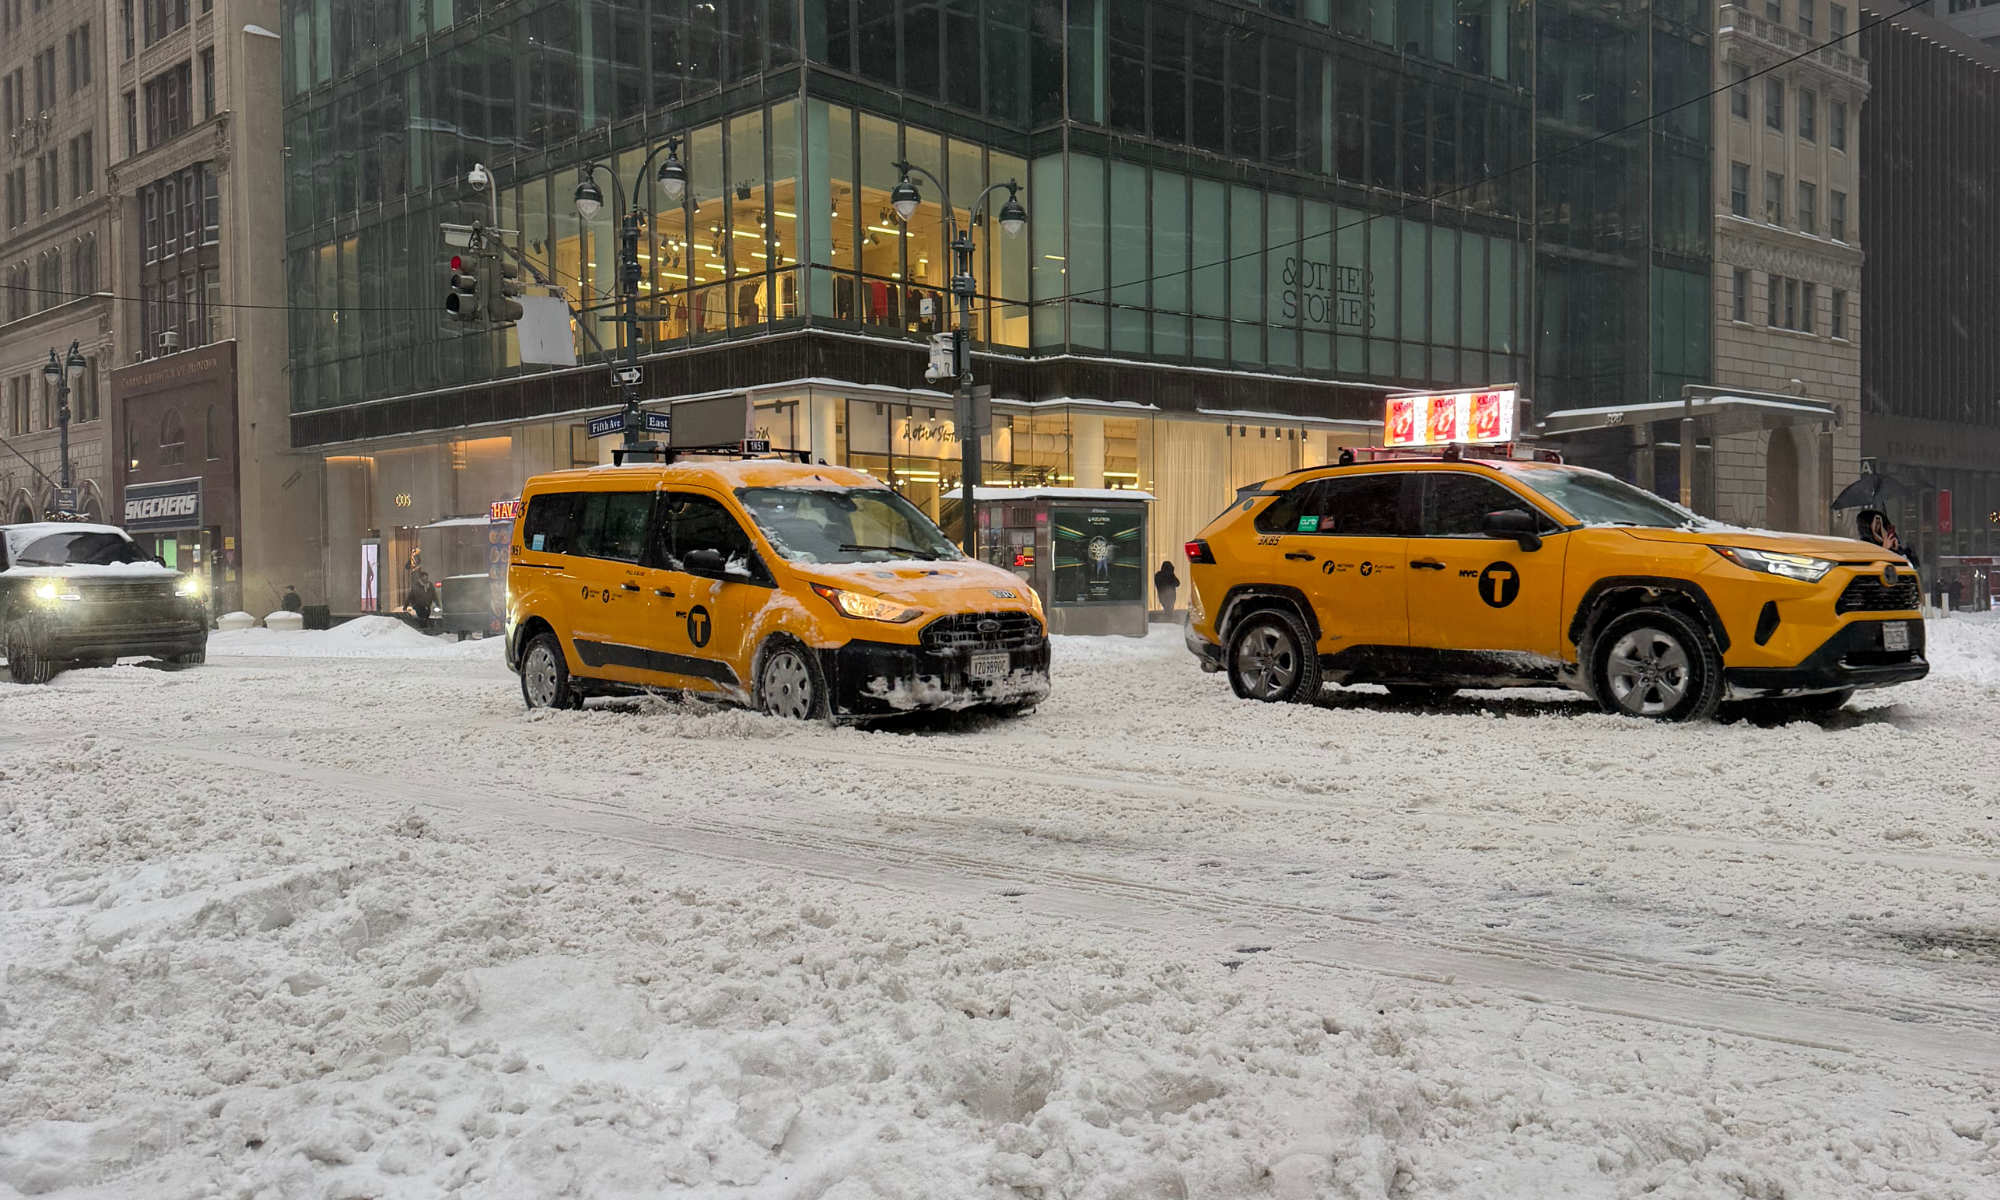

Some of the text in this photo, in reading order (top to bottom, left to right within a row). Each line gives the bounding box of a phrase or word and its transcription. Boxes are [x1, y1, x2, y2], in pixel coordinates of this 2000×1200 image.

[592, 419, 621, 433] Fifth Ave
[649, 417, 668, 428] East
[1862, 460, 1873, 475] A
[125, 494, 197, 520] SKECHERS
[395, 493, 411, 507] COS
[1459, 570, 1512, 602] NYC T
[692, 613, 706, 643] T
